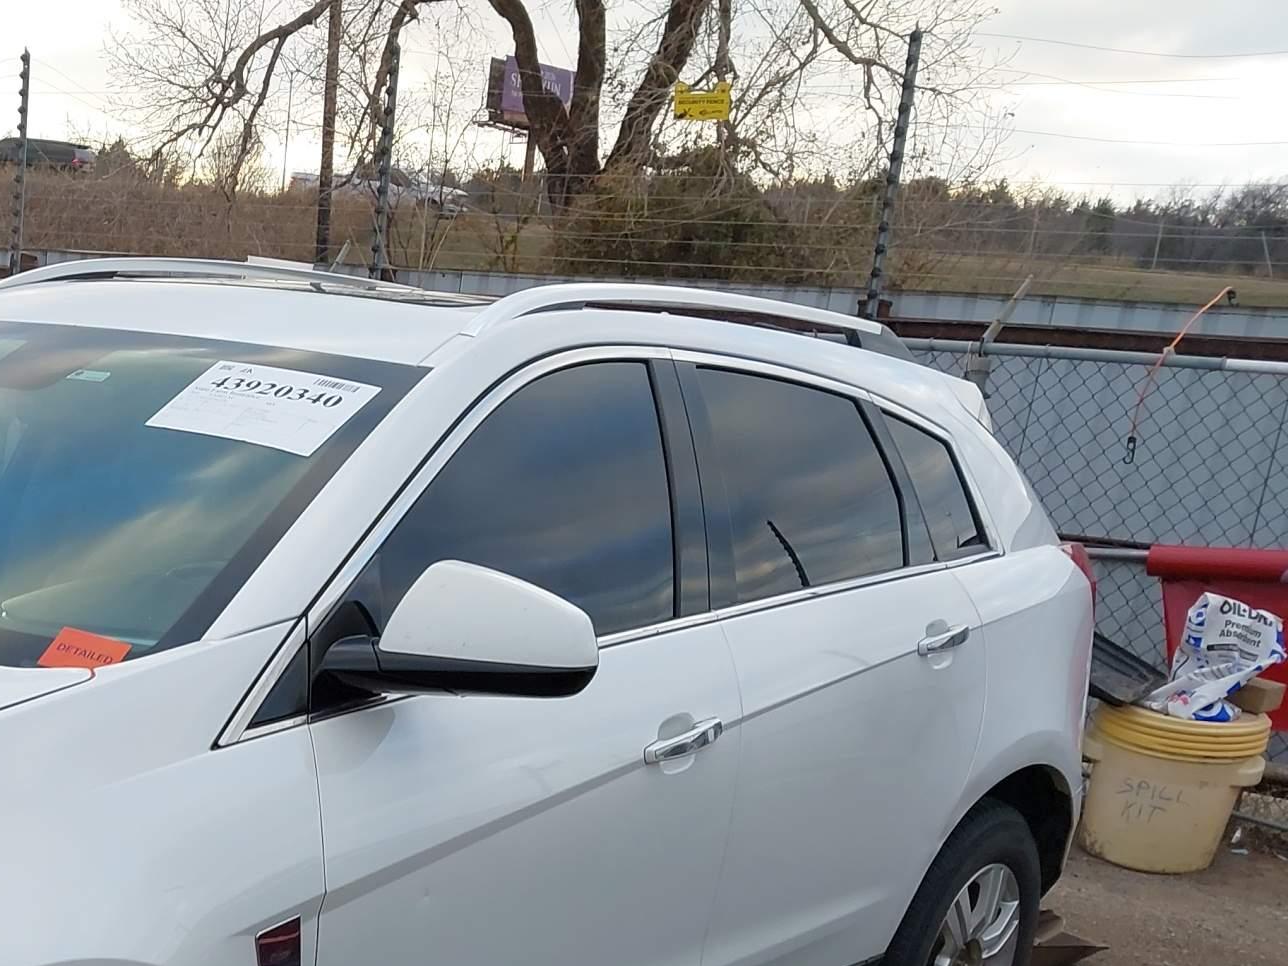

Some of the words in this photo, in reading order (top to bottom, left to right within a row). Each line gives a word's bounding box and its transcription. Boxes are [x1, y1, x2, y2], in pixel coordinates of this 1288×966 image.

[211, 376, 343, 408] 43920340
[1219, 629, 1262, 648] Absorbent
[1224, 620, 1262, 639] Premium
[56, 642, 113, 664] DETAILED
[1114, 776, 1192, 809] SPILL
[1120, 799, 1169, 824] KIT
